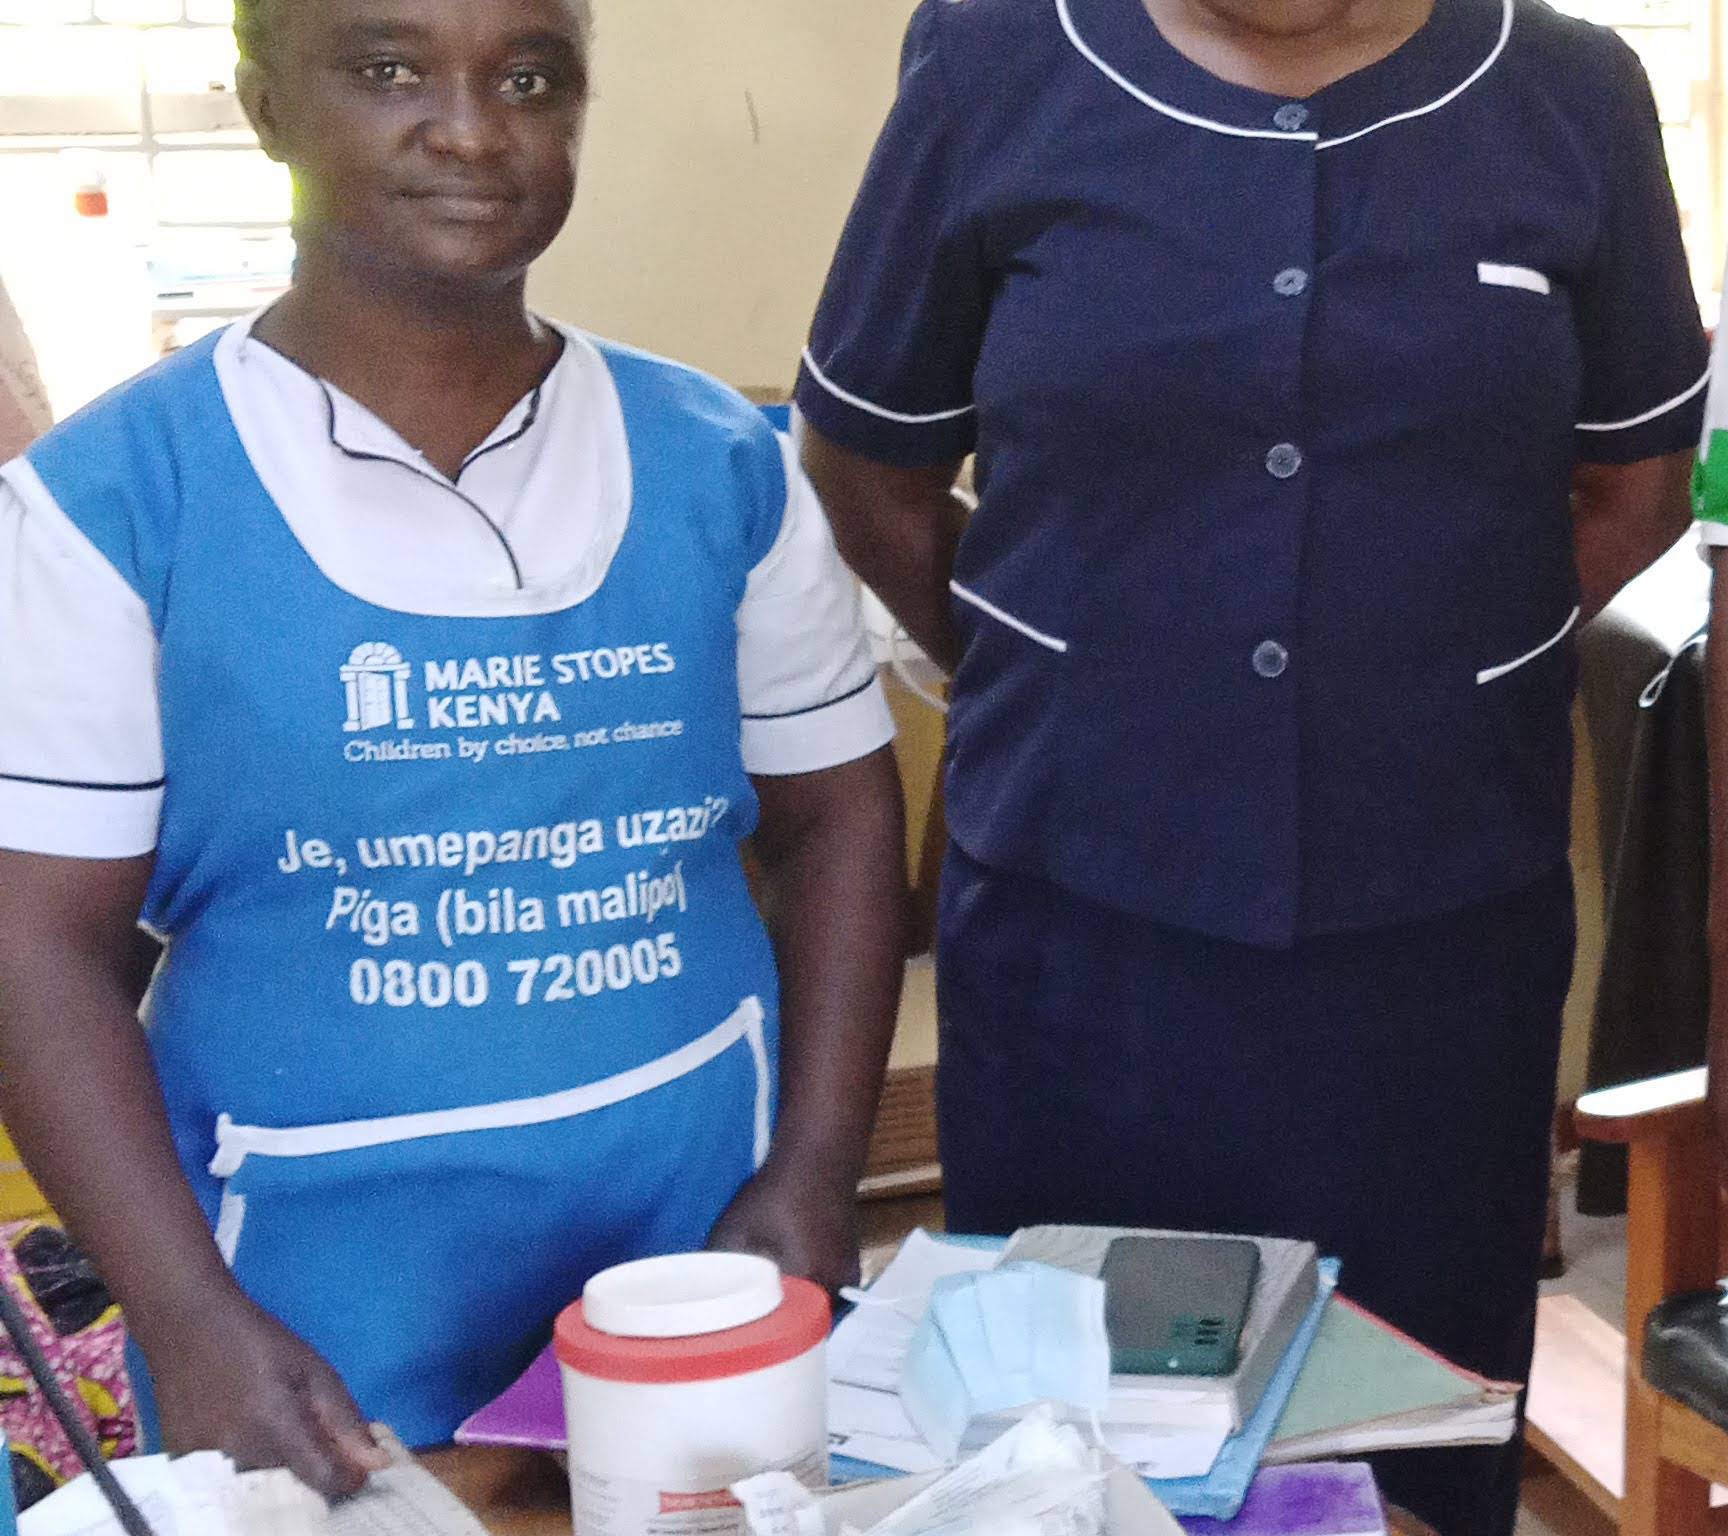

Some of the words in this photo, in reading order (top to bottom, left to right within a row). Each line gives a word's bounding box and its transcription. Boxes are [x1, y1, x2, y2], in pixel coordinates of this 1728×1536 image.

[424, 654, 545, 693] MARIE
[551, 642, 675, 685] STOPES
[427, 690, 561, 730] KENYA
[343, 736, 452, 763] Children
[457, 735, 489, 763] by
[573, 726, 609, 748] not
[611, 718, 685, 743] chance
[277, 829, 348, 877] Je,
[357, 817, 604, 877] umepanga
[616, 795, 730, 848] uzazi?
[325, 885, 420, 946] Piga
[436, 888, 545, 948] (bila
[349, 957, 489, 1008] 0800
[506, 931, 684, 1005] 720005
